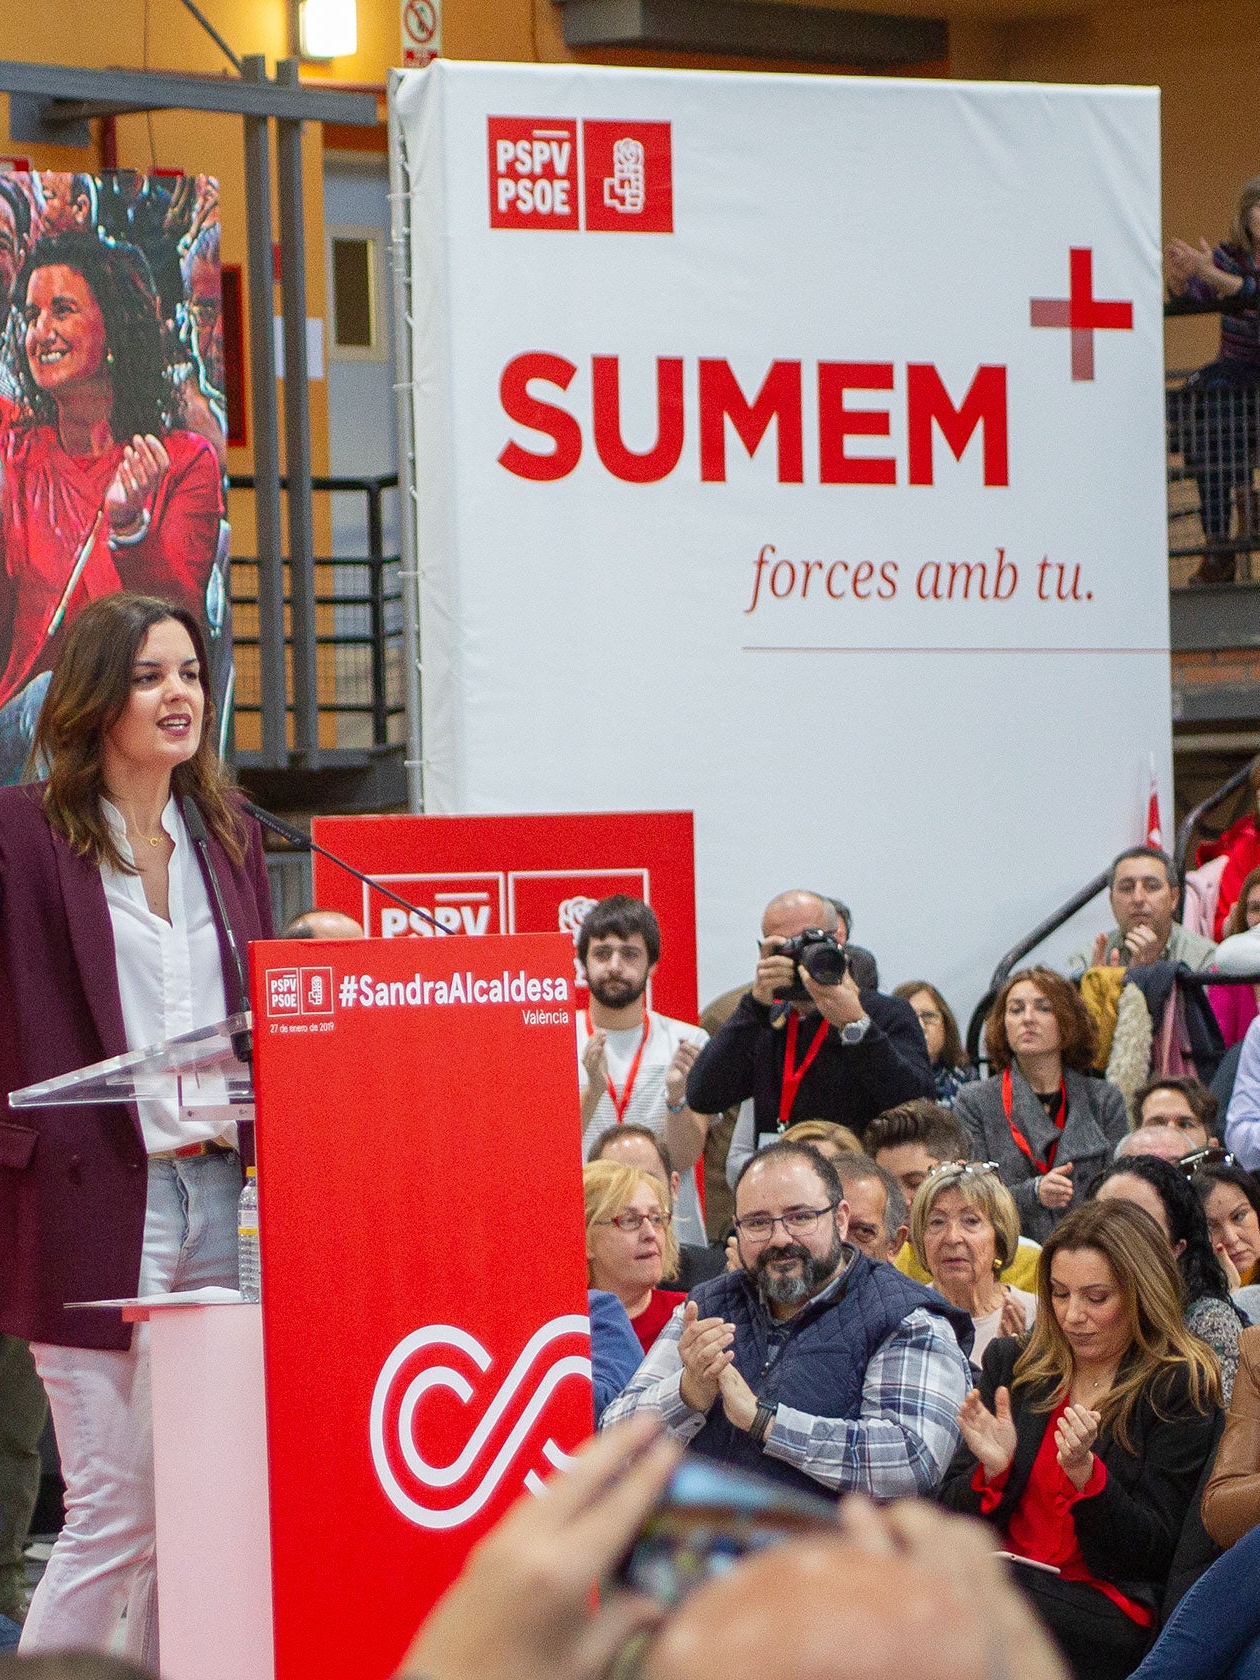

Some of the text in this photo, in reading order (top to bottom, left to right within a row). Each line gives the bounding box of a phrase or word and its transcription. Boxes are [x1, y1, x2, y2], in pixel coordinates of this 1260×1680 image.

[496, 139, 571, 176] PSPV
[497, 178, 571, 215] PSOE
[497, 350, 1009, 487] SUMEM
[743, 544, 1093, 615] forces amb tu.
[381, 905, 490, 939] PSPV
[270, 978, 297, 993] PSPV
[271, 993, 297, 1008] PSOE
[338, 970, 569, 1007] #SandraAlcaldesa
[269, 1021, 335, 1034] 27 de enero de 2019
[521, 1008, 569, 1025] València
